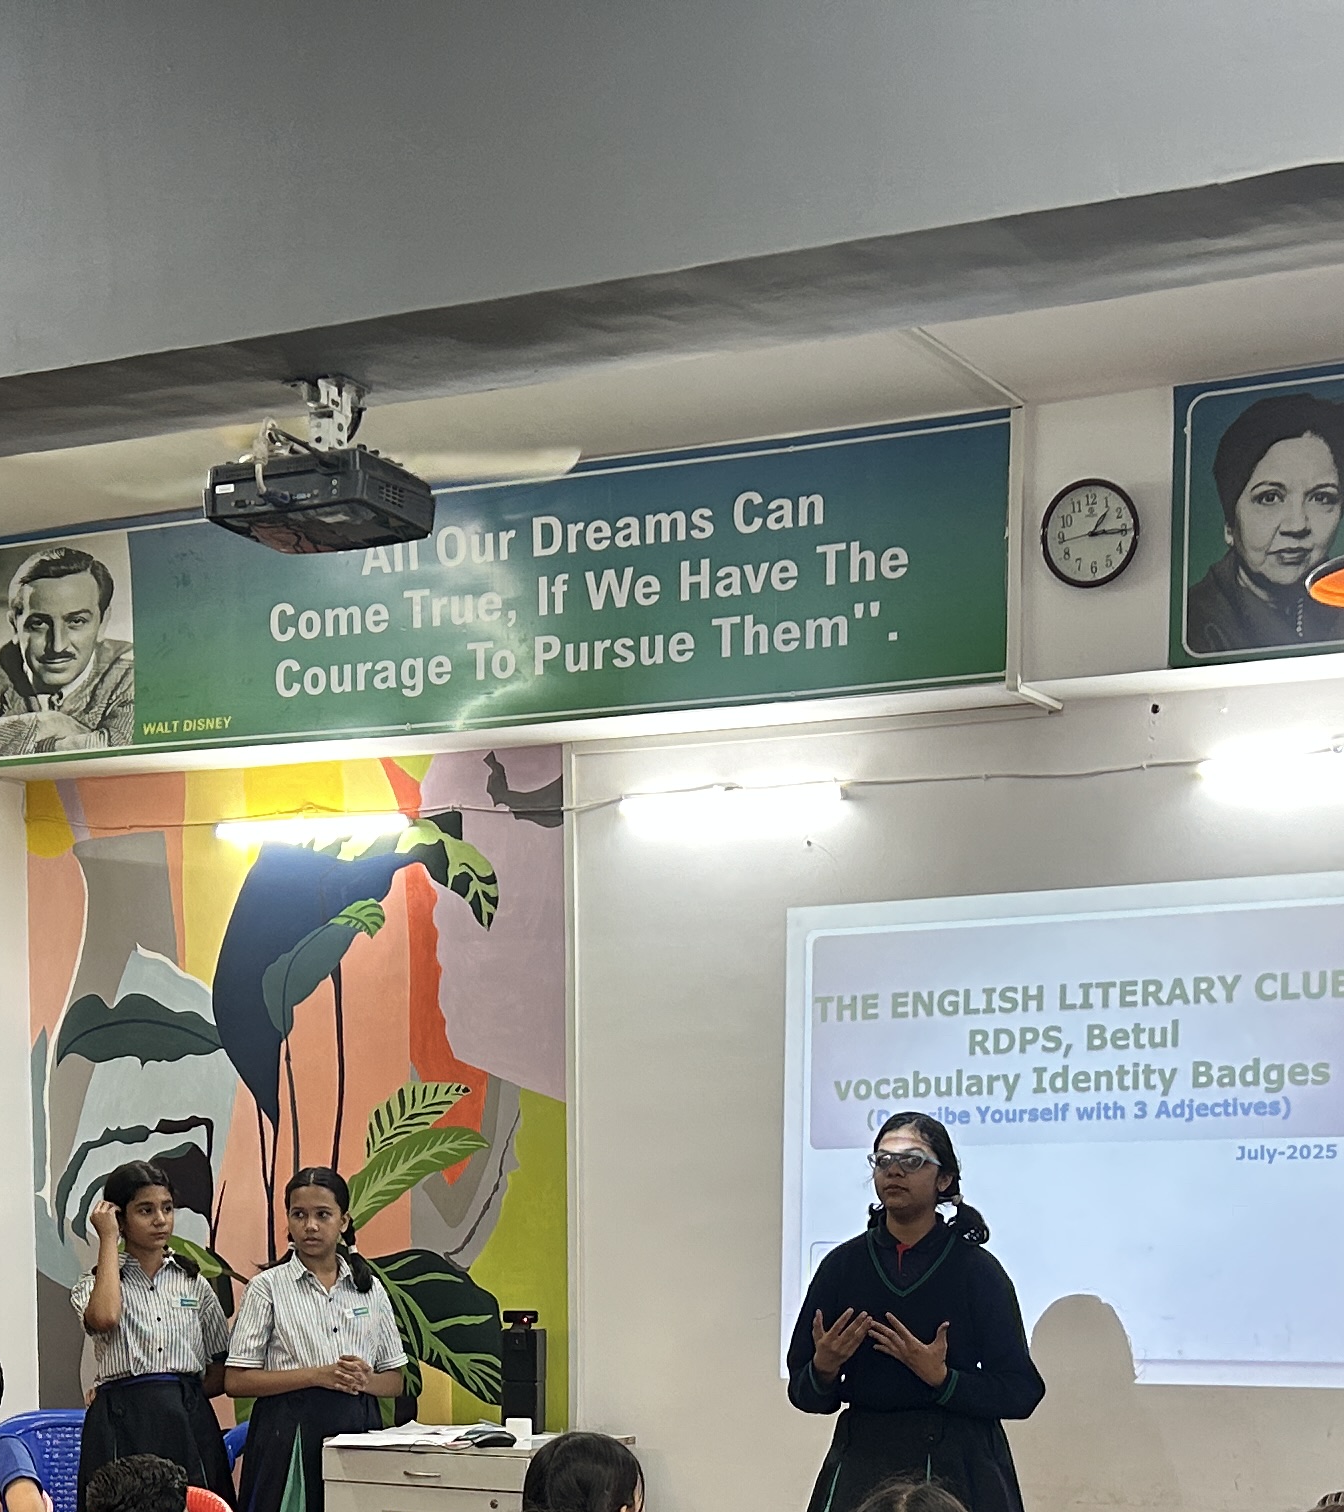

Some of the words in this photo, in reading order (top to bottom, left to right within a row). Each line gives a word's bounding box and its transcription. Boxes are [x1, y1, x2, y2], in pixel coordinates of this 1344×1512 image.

[361, 538, 420, 576] All
[436, 525, 516, 567] Our
[532, 507, 714, 557] Dreams
[733, 491, 824, 534] Can
[269, 602, 390, 642] Come
[403, 588, 516, 628] True,
[537, 573, 569, 616] If
[584, 566, 661, 611] We
[679, 558, 798, 602] Have
[816, 540, 909, 586] The
[274, 654, 452, 698] Courage
[467, 641, 516, 681] To
[534, 629, 695, 675] Pursue
[142, 720, 179, 736] WALT
[182, 715, 232, 732] DISNEY
[813, 993, 880, 1023] THE
[891, 984, 1045, 1020] ENGLISH
[1059, 973, 1243, 1011] LITERARY
[968, 1025, 1074, 1058] RDPS,
[1086, 1018, 1180, 1052] Betul
[833, 1068, 1022, 1102] vocabulary
[1031, 1062, 1178, 1097] Identity
[1191, 1057, 1332, 1094] Badges
[975, 1102, 1070, 1124] Yourself
[1076, 1101, 1126, 1121] with
[1133, 1100, 1148, 1119] 3
[1156, 1096, 1292, 1122] Adjectives)
[1236, 1143, 1338, 1164] July-2025
